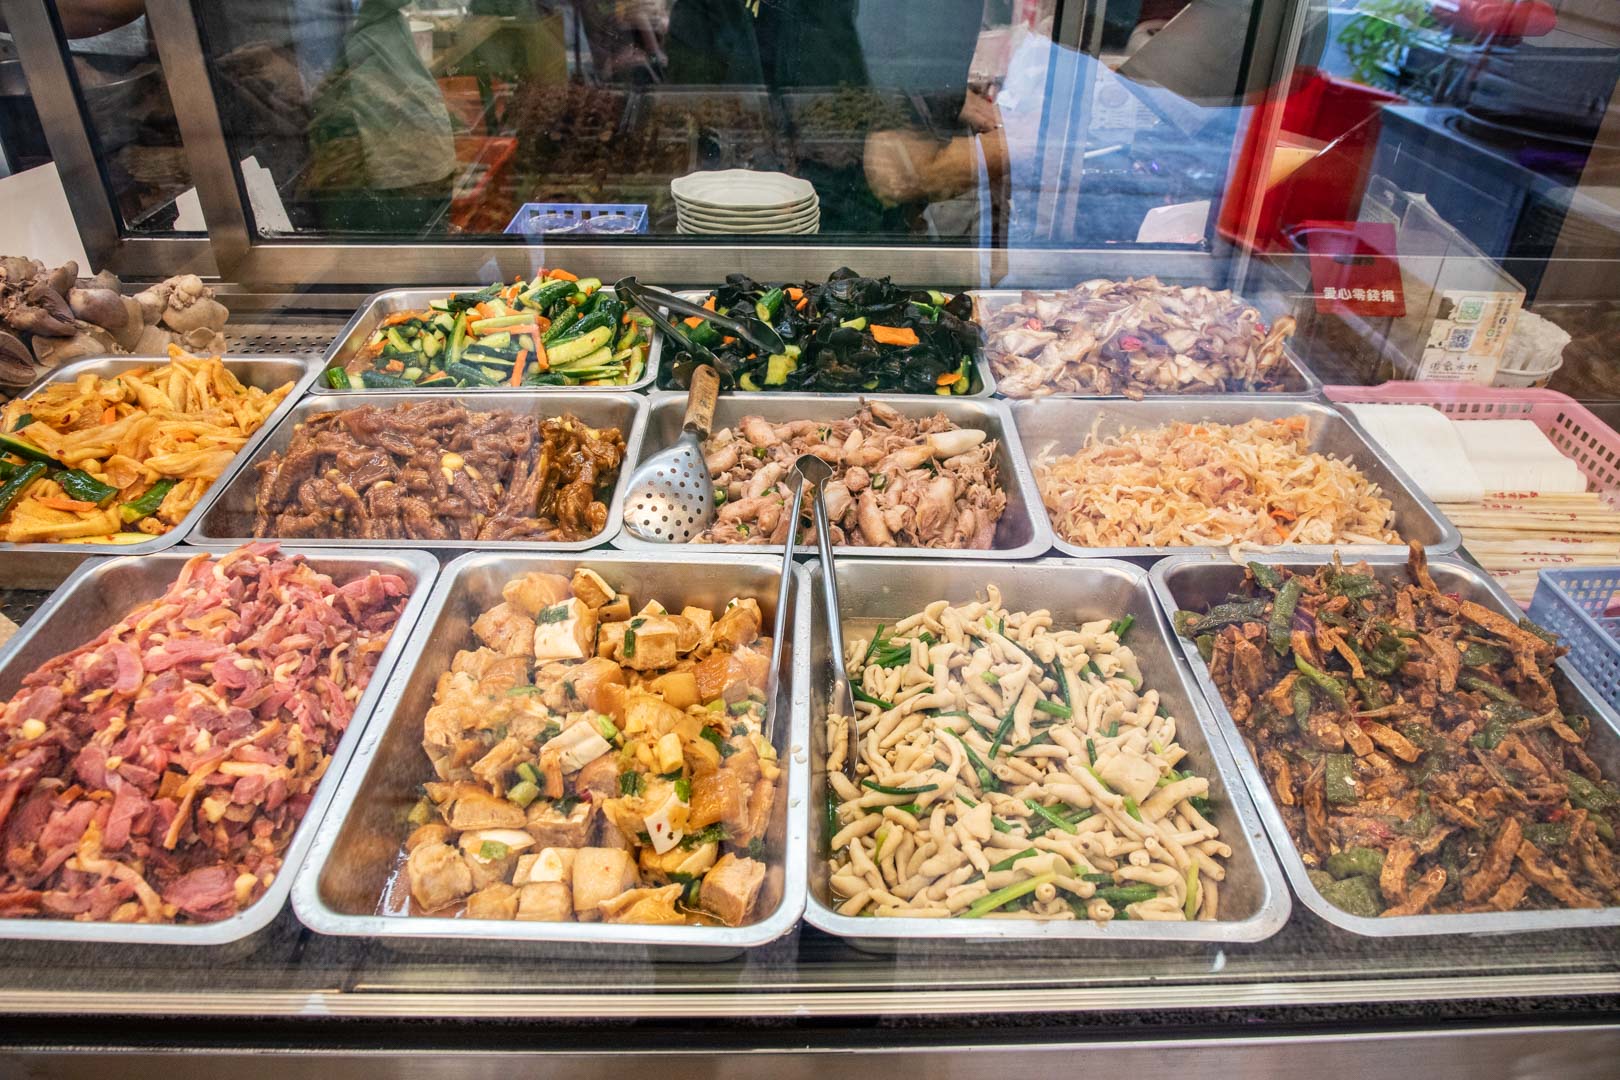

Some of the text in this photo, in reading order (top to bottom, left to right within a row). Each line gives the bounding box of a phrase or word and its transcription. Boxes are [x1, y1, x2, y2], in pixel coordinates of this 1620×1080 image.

[1323, 287, 1395, 302] 愛心零錢捐
